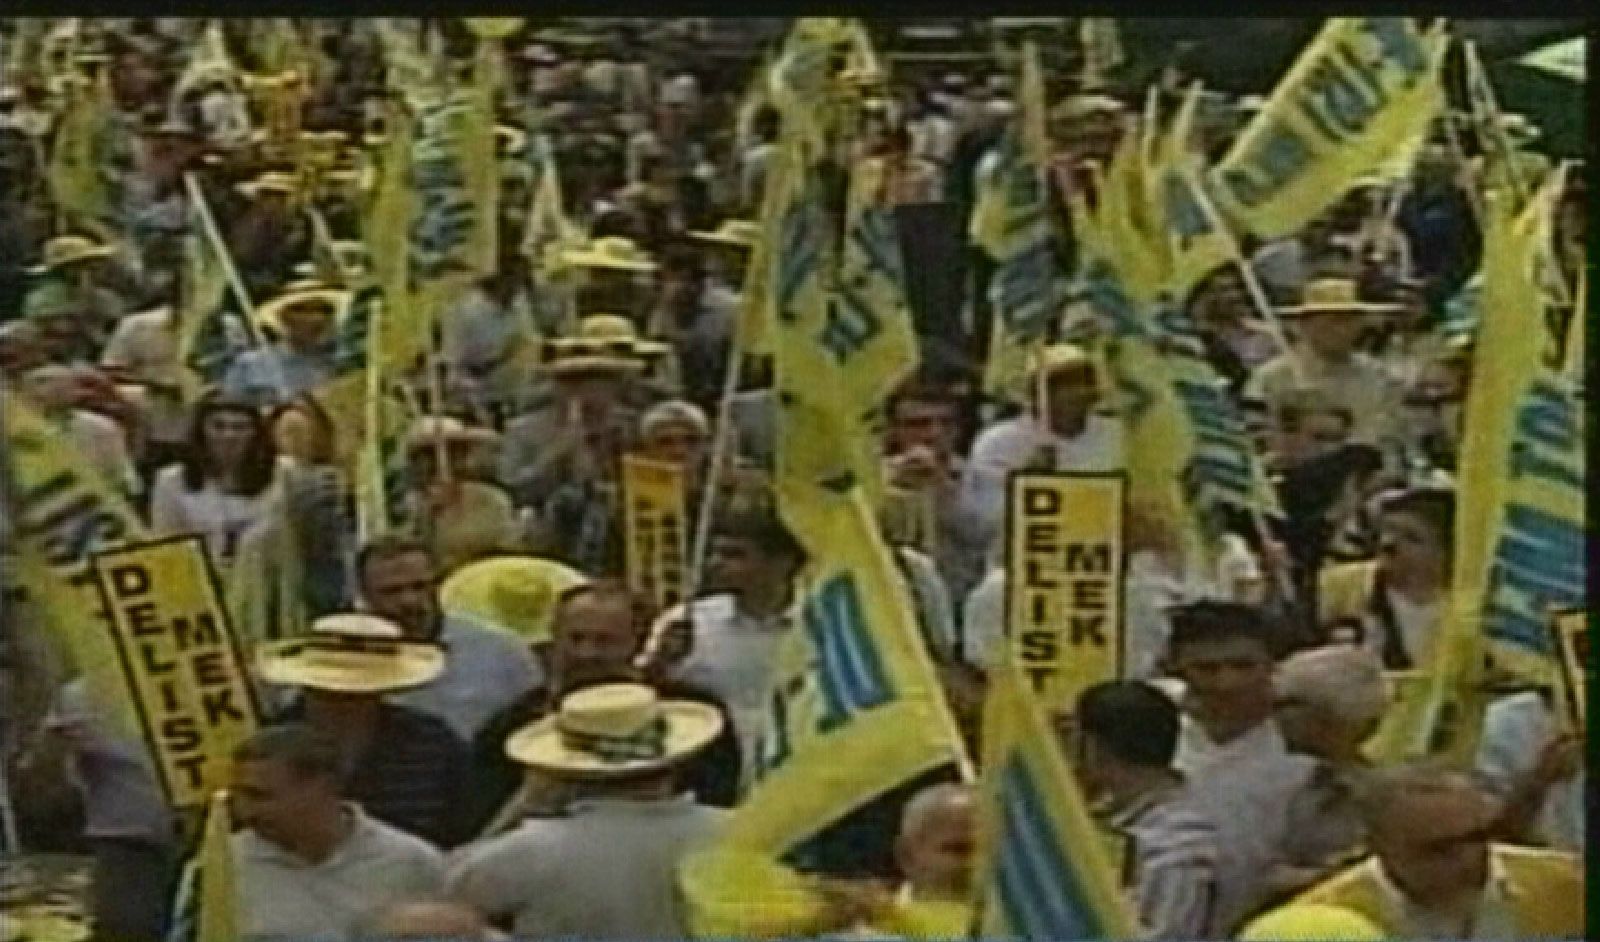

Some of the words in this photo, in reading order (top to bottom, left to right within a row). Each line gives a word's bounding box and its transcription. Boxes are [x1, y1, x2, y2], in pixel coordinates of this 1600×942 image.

[171, 612, 243, 727] MEK
[1021, 487, 1062, 693] DELIST
[1065, 543, 1111, 647] MEK
[111, 564, 206, 790] DELIST
